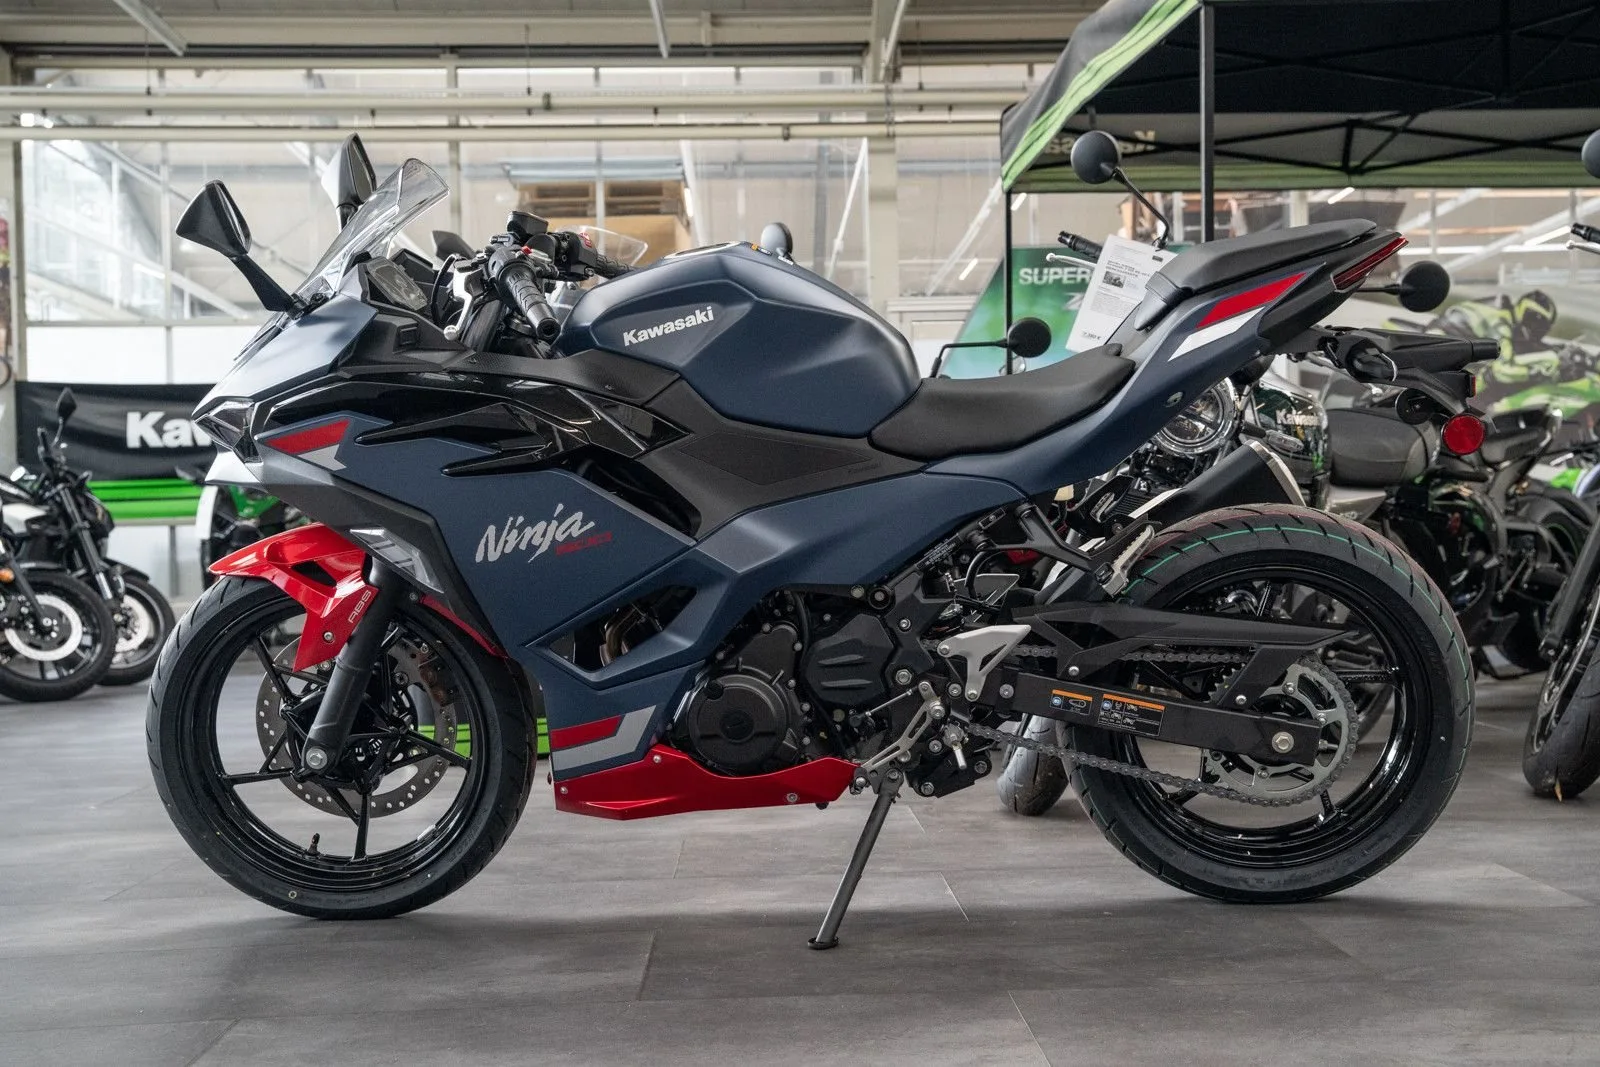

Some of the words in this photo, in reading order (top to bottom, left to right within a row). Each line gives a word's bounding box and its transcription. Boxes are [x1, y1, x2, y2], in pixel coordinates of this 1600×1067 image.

[1019, 267, 1092, 285] SUPER
[622, 306, 714, 347] Kawasaki
[475, 503, 596, 563] Ninja
[348, 589, 372, 624] ABS
